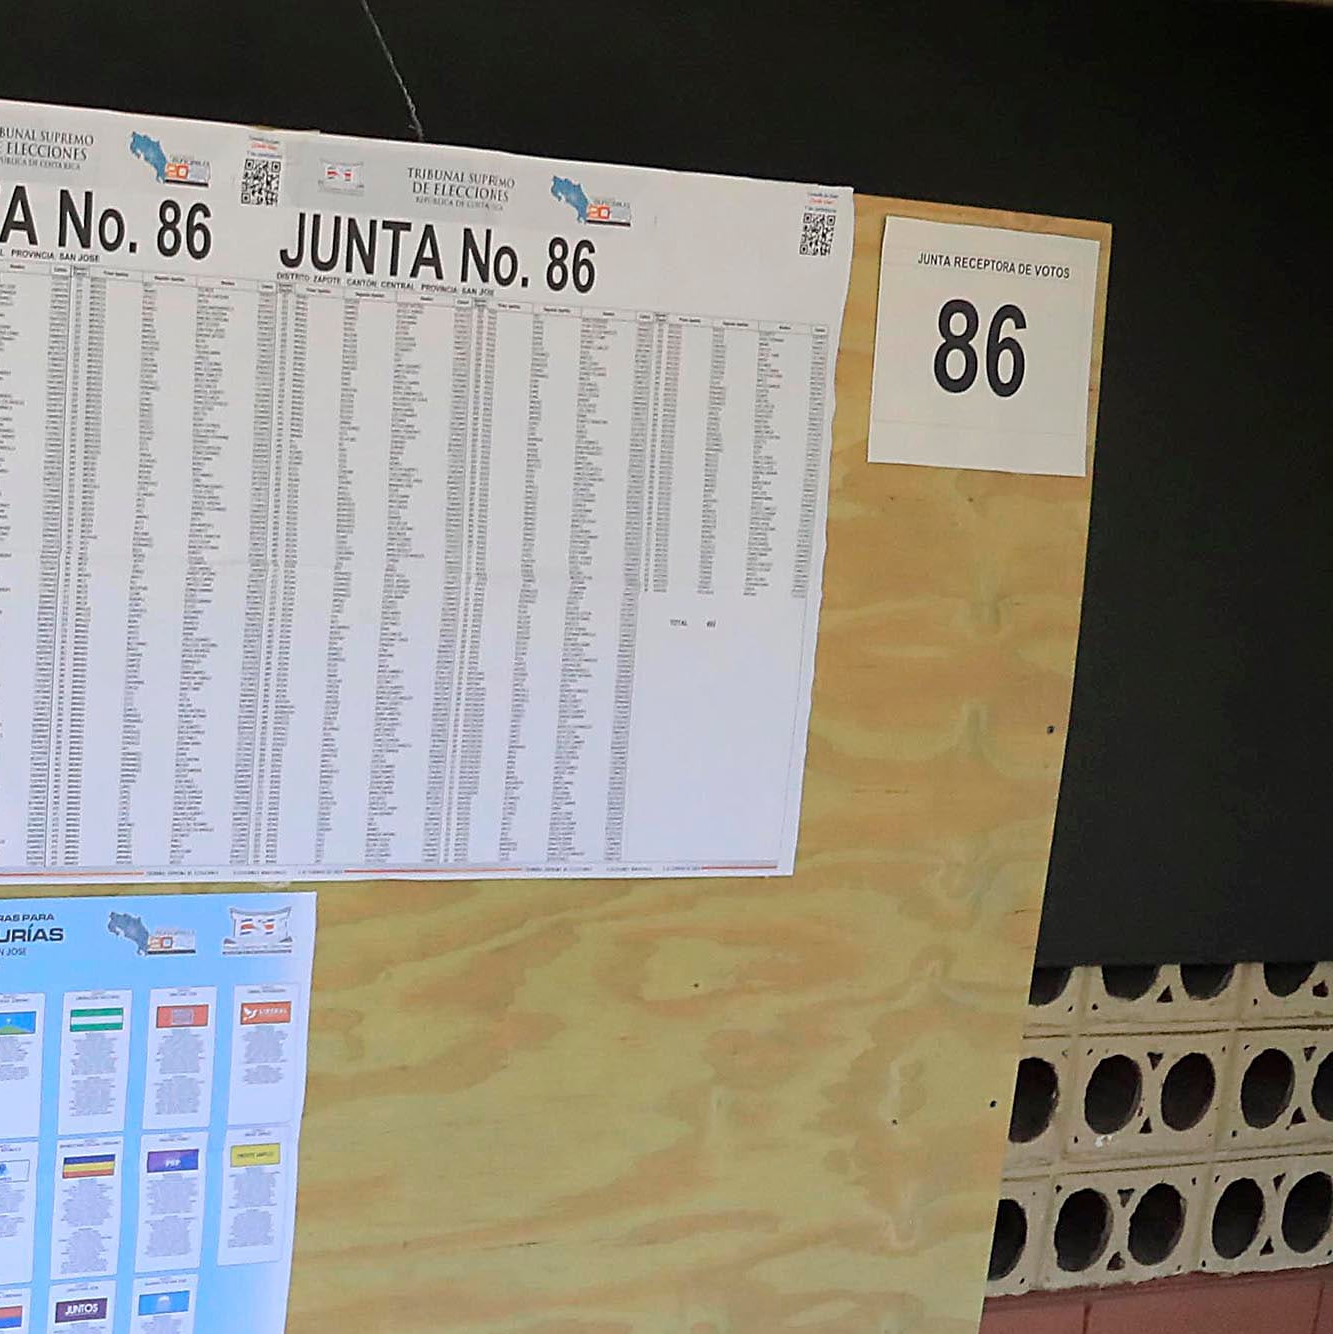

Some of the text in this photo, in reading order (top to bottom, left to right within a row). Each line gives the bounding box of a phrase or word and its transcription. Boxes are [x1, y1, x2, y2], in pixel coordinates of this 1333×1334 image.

[41, 130, 94, 147] SUPREMO
[7, 141, 87, 160] ELECCIONES
[407, 167, 515, 189] TRIBUNAL SUPREMO
[413, 181, 509, 202] DE ELECCIONES
[59, 190, 137, 254] No.
[157, 200, 212, 259] 86
[60, 253, 75, 261] SAN
[279, 213, 596, 293] JUNTA No. 86
[917, 253, 1070, 278] JUNTA RECEPTORA DE VOTOS
[933, 299, 1027, 398] 86
[22, 913, 54, 922] PARA
[65, 1303, 99, 1316] JUNTOS
